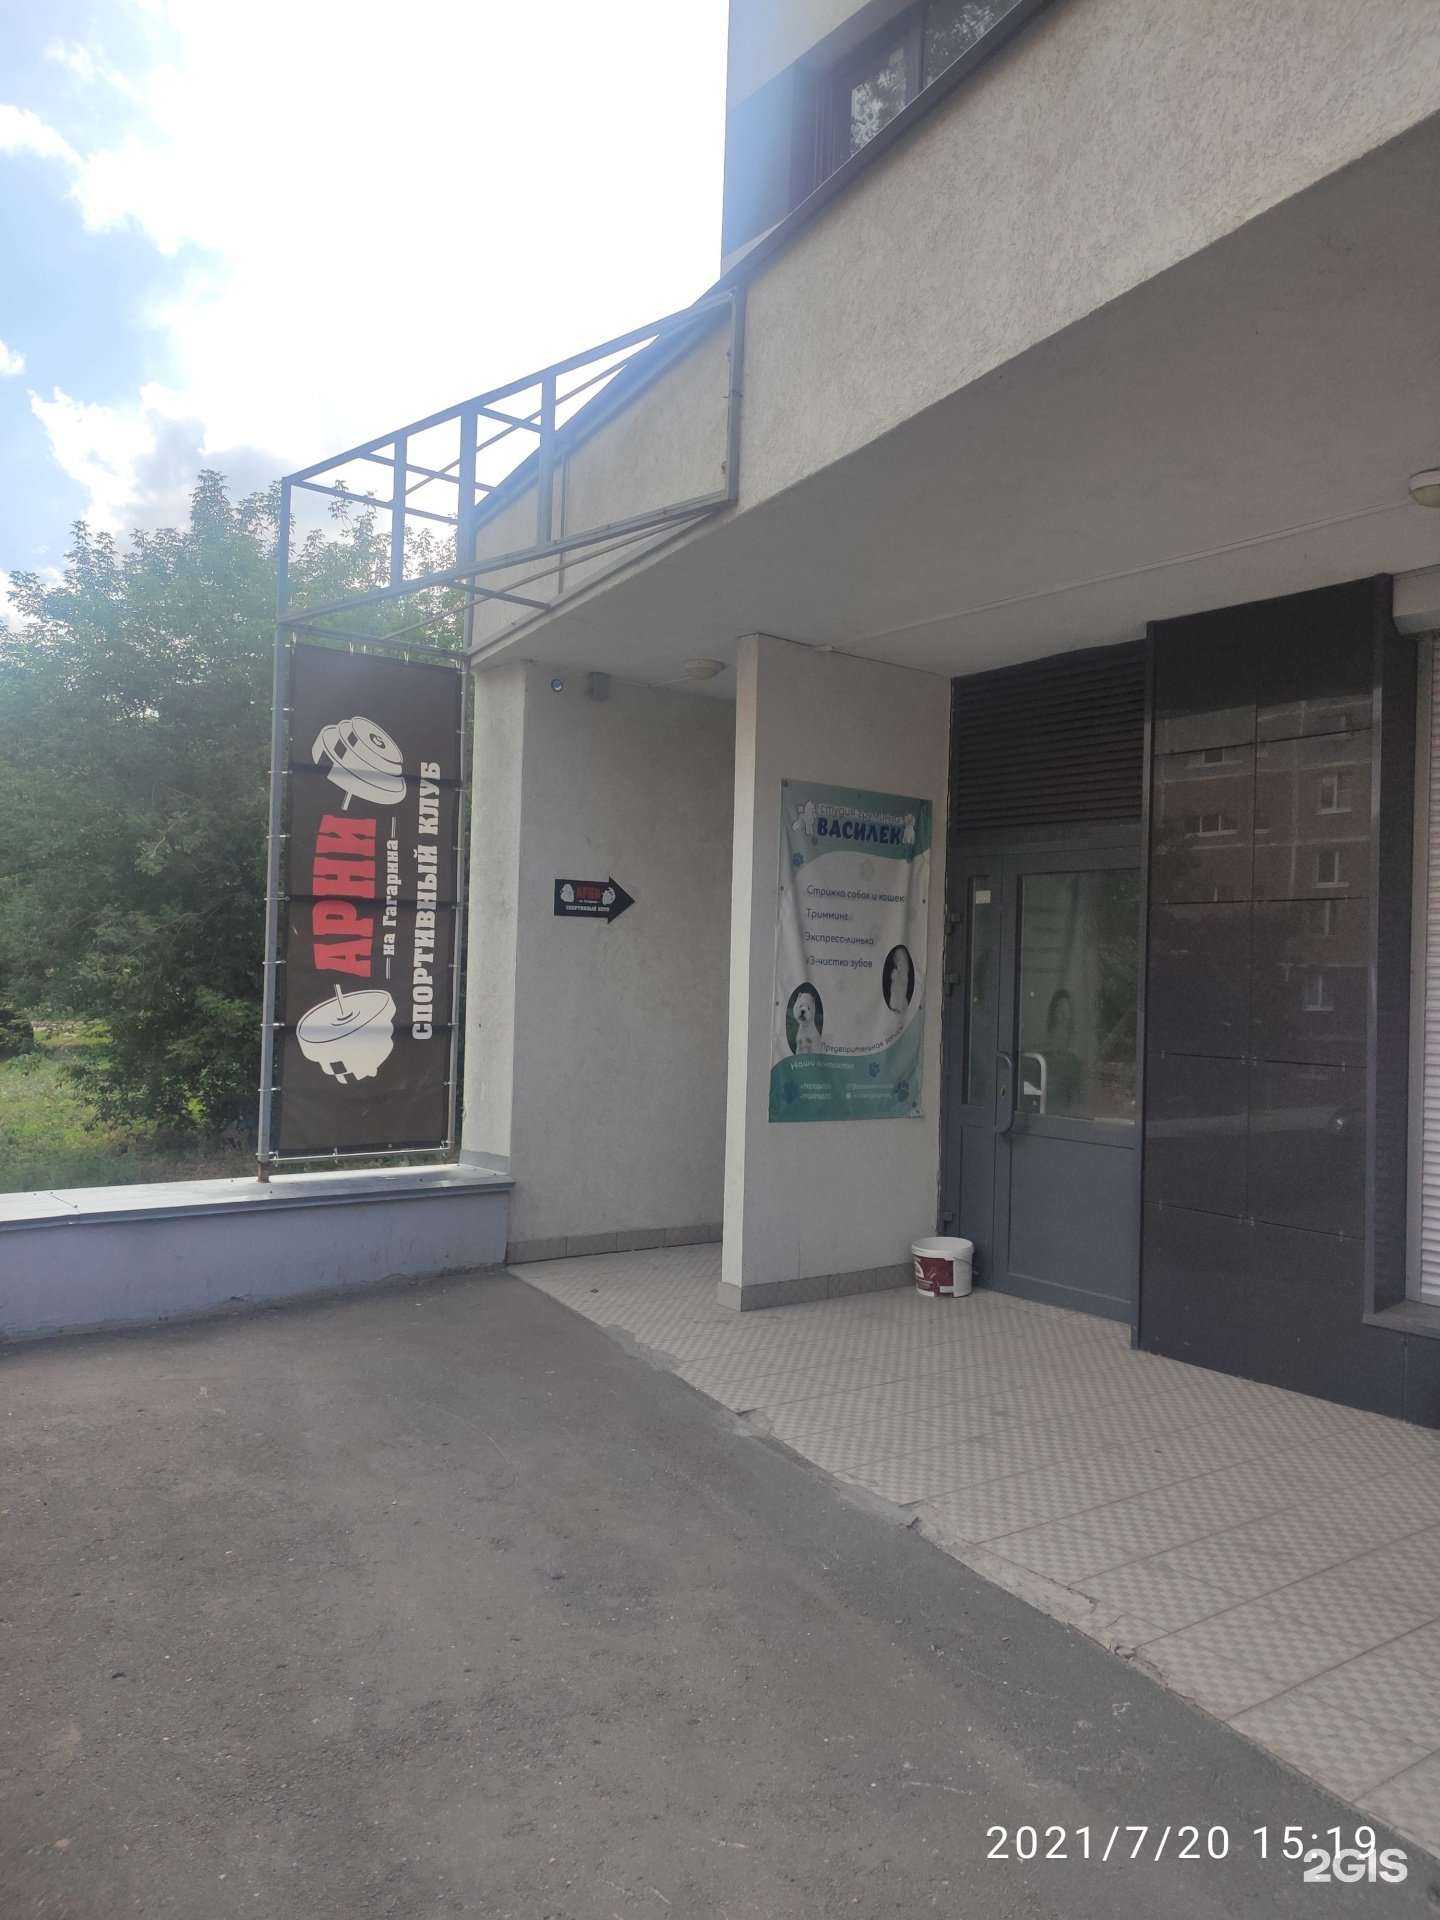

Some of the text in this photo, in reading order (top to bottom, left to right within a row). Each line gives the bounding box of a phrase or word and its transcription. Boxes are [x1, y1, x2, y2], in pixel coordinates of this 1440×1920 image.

[312, 813, 377, 979] АРНИ
[381, 839, 402, 956] на Гагарина
[411, 761, 441, 1040] СПОРТИВНЫЙ КЛУБ
[806, 885, 845, 898] Стрижка
[846, 889, 870, 901] собак
[878, 894, 905, 903] кошек
[849, 957, 872, 970] зубов
